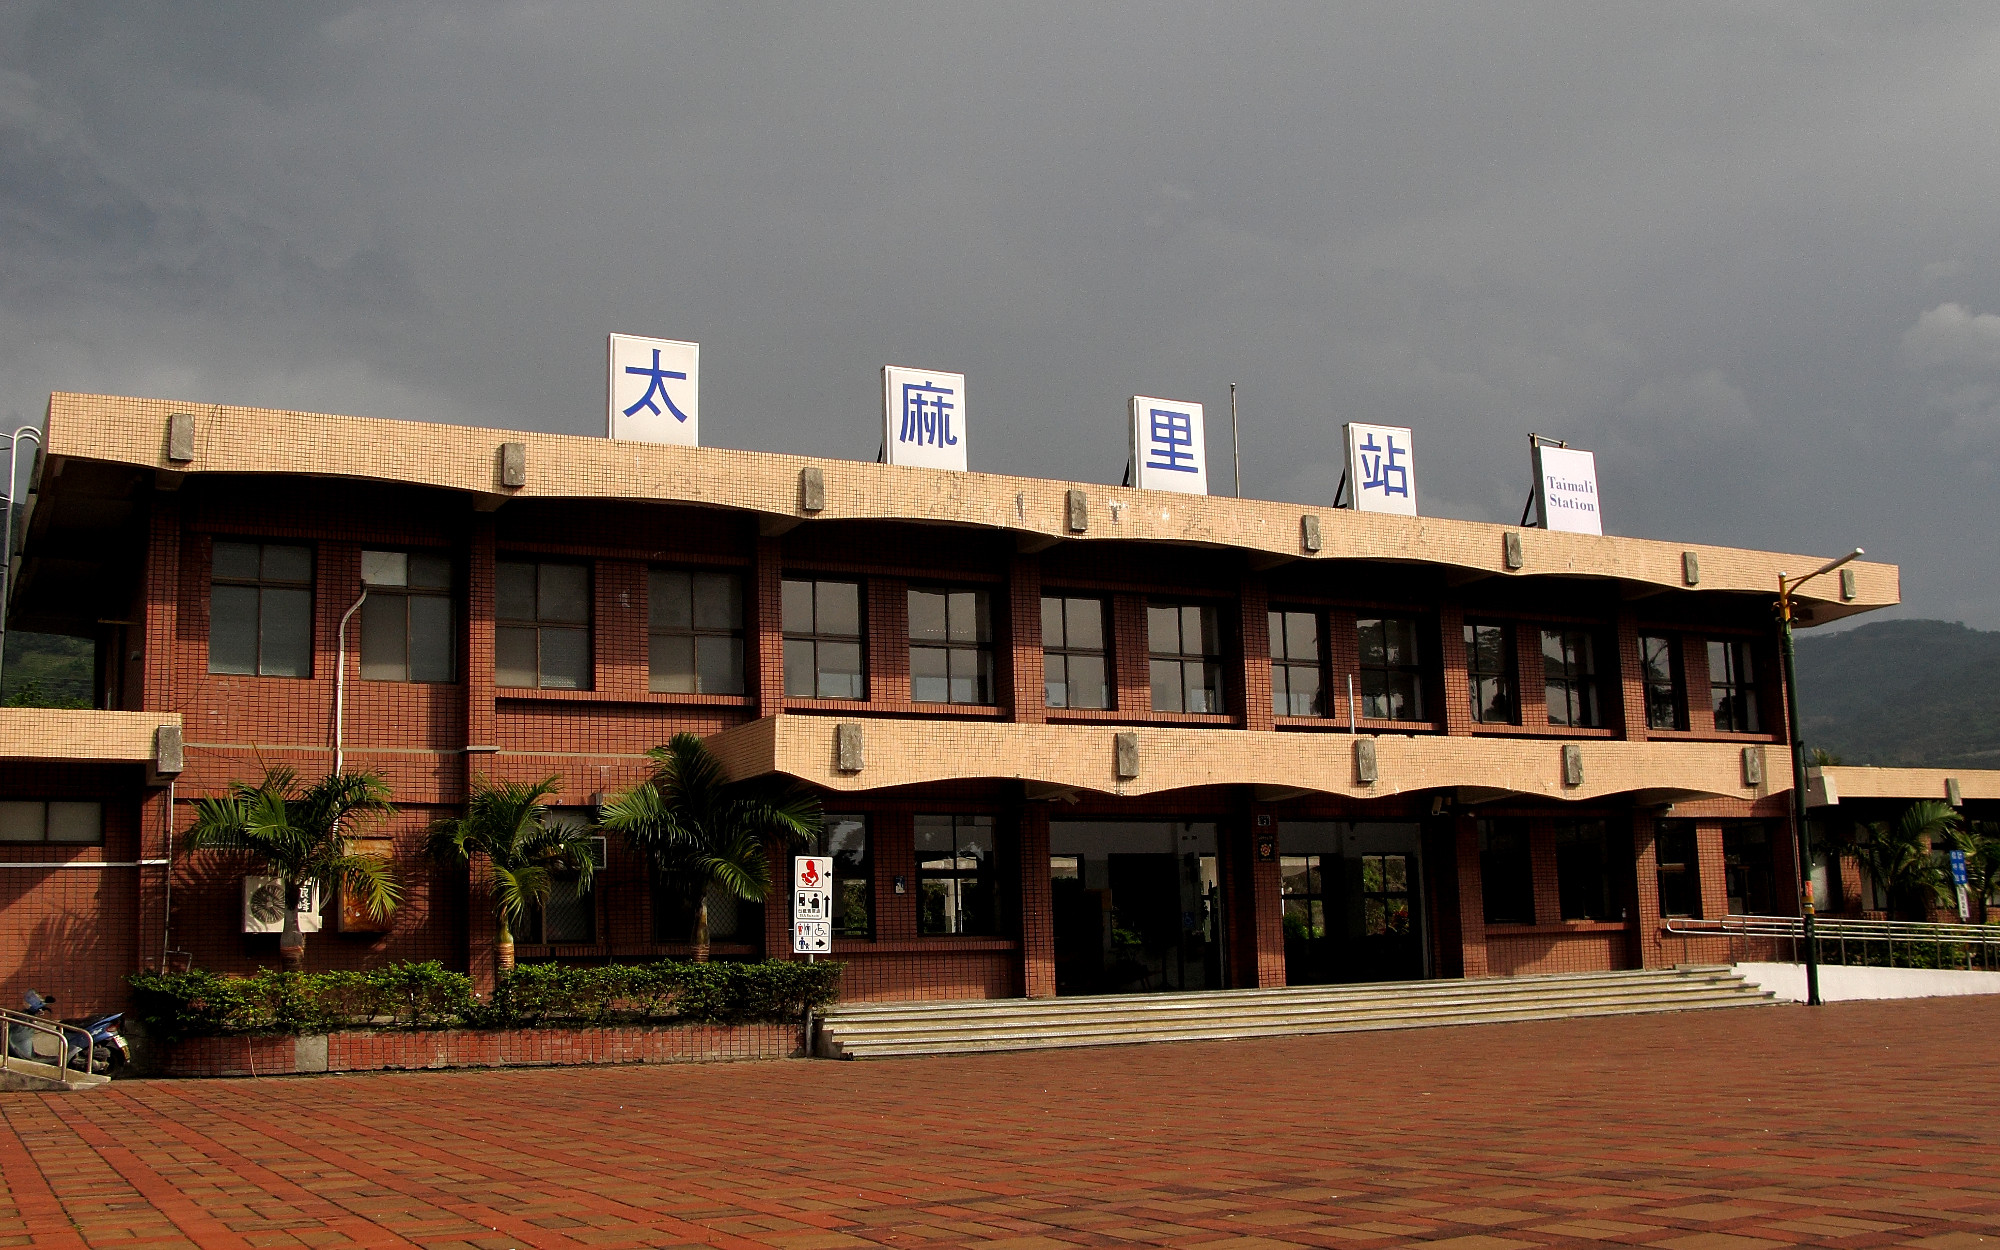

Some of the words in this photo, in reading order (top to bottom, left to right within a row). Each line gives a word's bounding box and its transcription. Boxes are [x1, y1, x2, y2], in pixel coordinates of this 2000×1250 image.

[623, 349, 688, 423] 太
[900, 381, 957, 448] 麻
[1146, 408, 1199, 473] 里
[1360, 433, 1408, 498] 站
[1546, 475, 1594, 494] Taimali
[1549, 493, 1595, 512] Station
